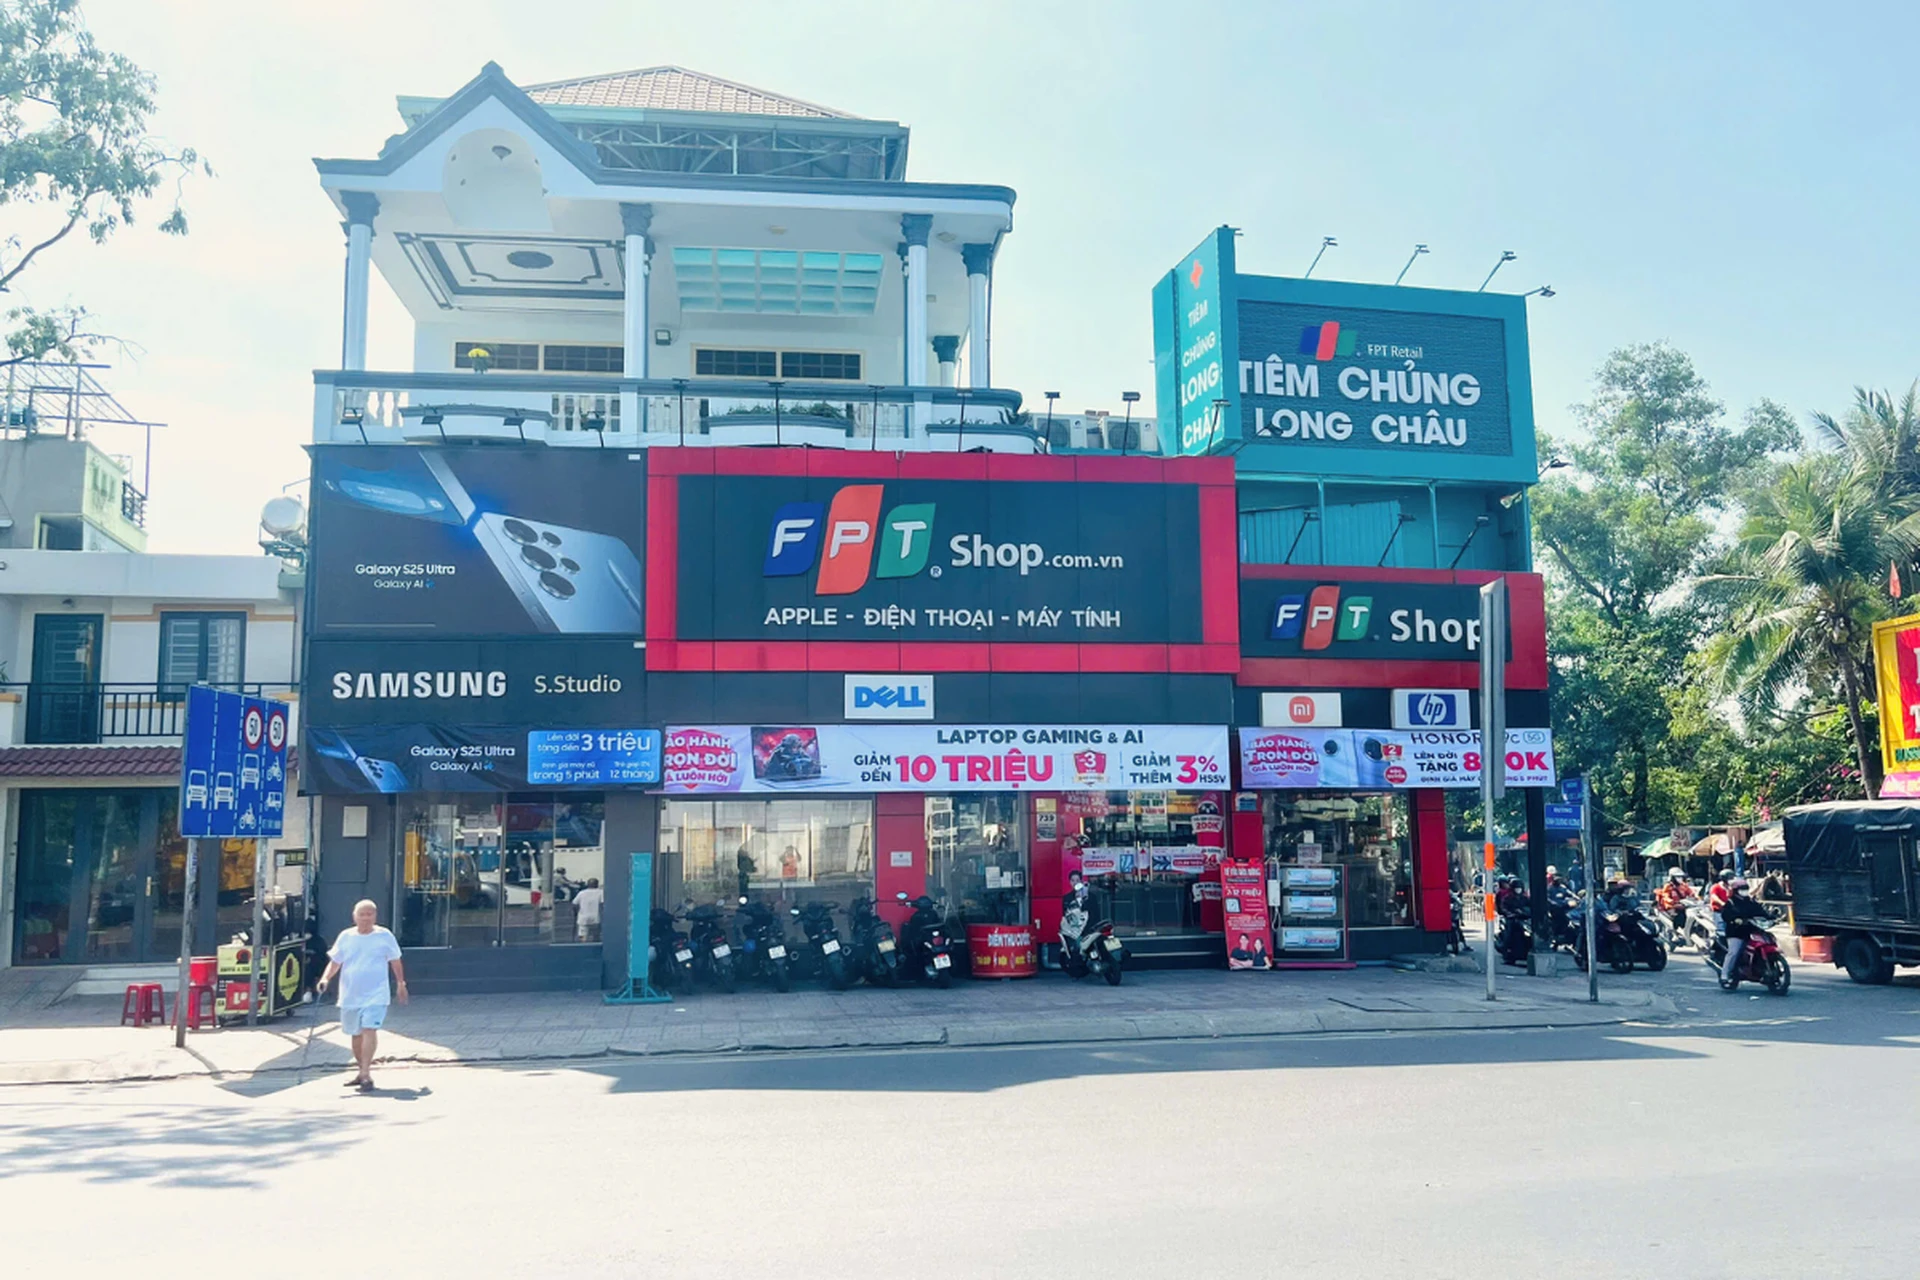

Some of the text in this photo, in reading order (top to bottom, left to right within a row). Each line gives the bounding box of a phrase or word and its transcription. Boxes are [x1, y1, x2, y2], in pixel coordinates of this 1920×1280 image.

[1188, 300, 1208, 328] TIÊM
[1367, 344, 1423, 358] FPT Retail
[1181, 361, 1219, 407] LONG
[1239, 353, 1481, 406] TIÊM CHỦNG
[1182, 406, 1221, 448] CHÂU
[1255, 407, 1466, 446] LONG CHÂU
[950, 534, 1123, 575] Shop.com.vn
[355, 564, 456, 577] Galaxy S25 Ultra
[374, 579, 423, 590] Galaxy AI
[764, 608, 837, 626] APPLE
[864, 604, 916, 629] ĐIỆN
[925, 609, 993, 630] THOẠI
[1018, 606, 1062, 627] MÁY
[1071, 606, 1121, 628] TÍNH
[1390, 609, 1480, 650] Shop
[333, 671, 622, 699] SAMSUNG S.Studio
[854, 685, 926, 708] DELL
[1422, 695, 1444, 725] hp
[249, 717, 258, 738] 50
[273, 721, 281, 740] 50
[581, 732, 651, 756] 3 triệu
[665, 733, 731, 750] ẢO HÀNH
[937, 729, 1144, 744] LAPTOP GAMING & AI
[410, 745, 515, 759] Galaxy S25 Ultra
[854, 751, 891, 766] GIẢM
[1387, 745, 1397, 755] 2
[1414, 751, 1435, 760] LÊN
[430, 761, 482, 773] Galaxy AI
[664, 750, 737, 769] RỌN ĐỜI
[1132, 751, 1171, 767] GIẢM
[1417, 751, 1549, 774] TẶNG 80K
[533, 771, 563, 783] trong
[574, 770, 600, 782] phút
[610, 770, 619, 779] 12
[622, 770, 655, 781] tháng
[676, 770, 706, 782] LUÔN
[860, 767, 891, 782] ĐẾN
[894, 748, 1054, 788] 10 TRIỆU
[1129, 770, 1172, 784] THÊM
[1199, 775, 1226, 784] HSSV
[1039, 814, 1054, 822] 739
